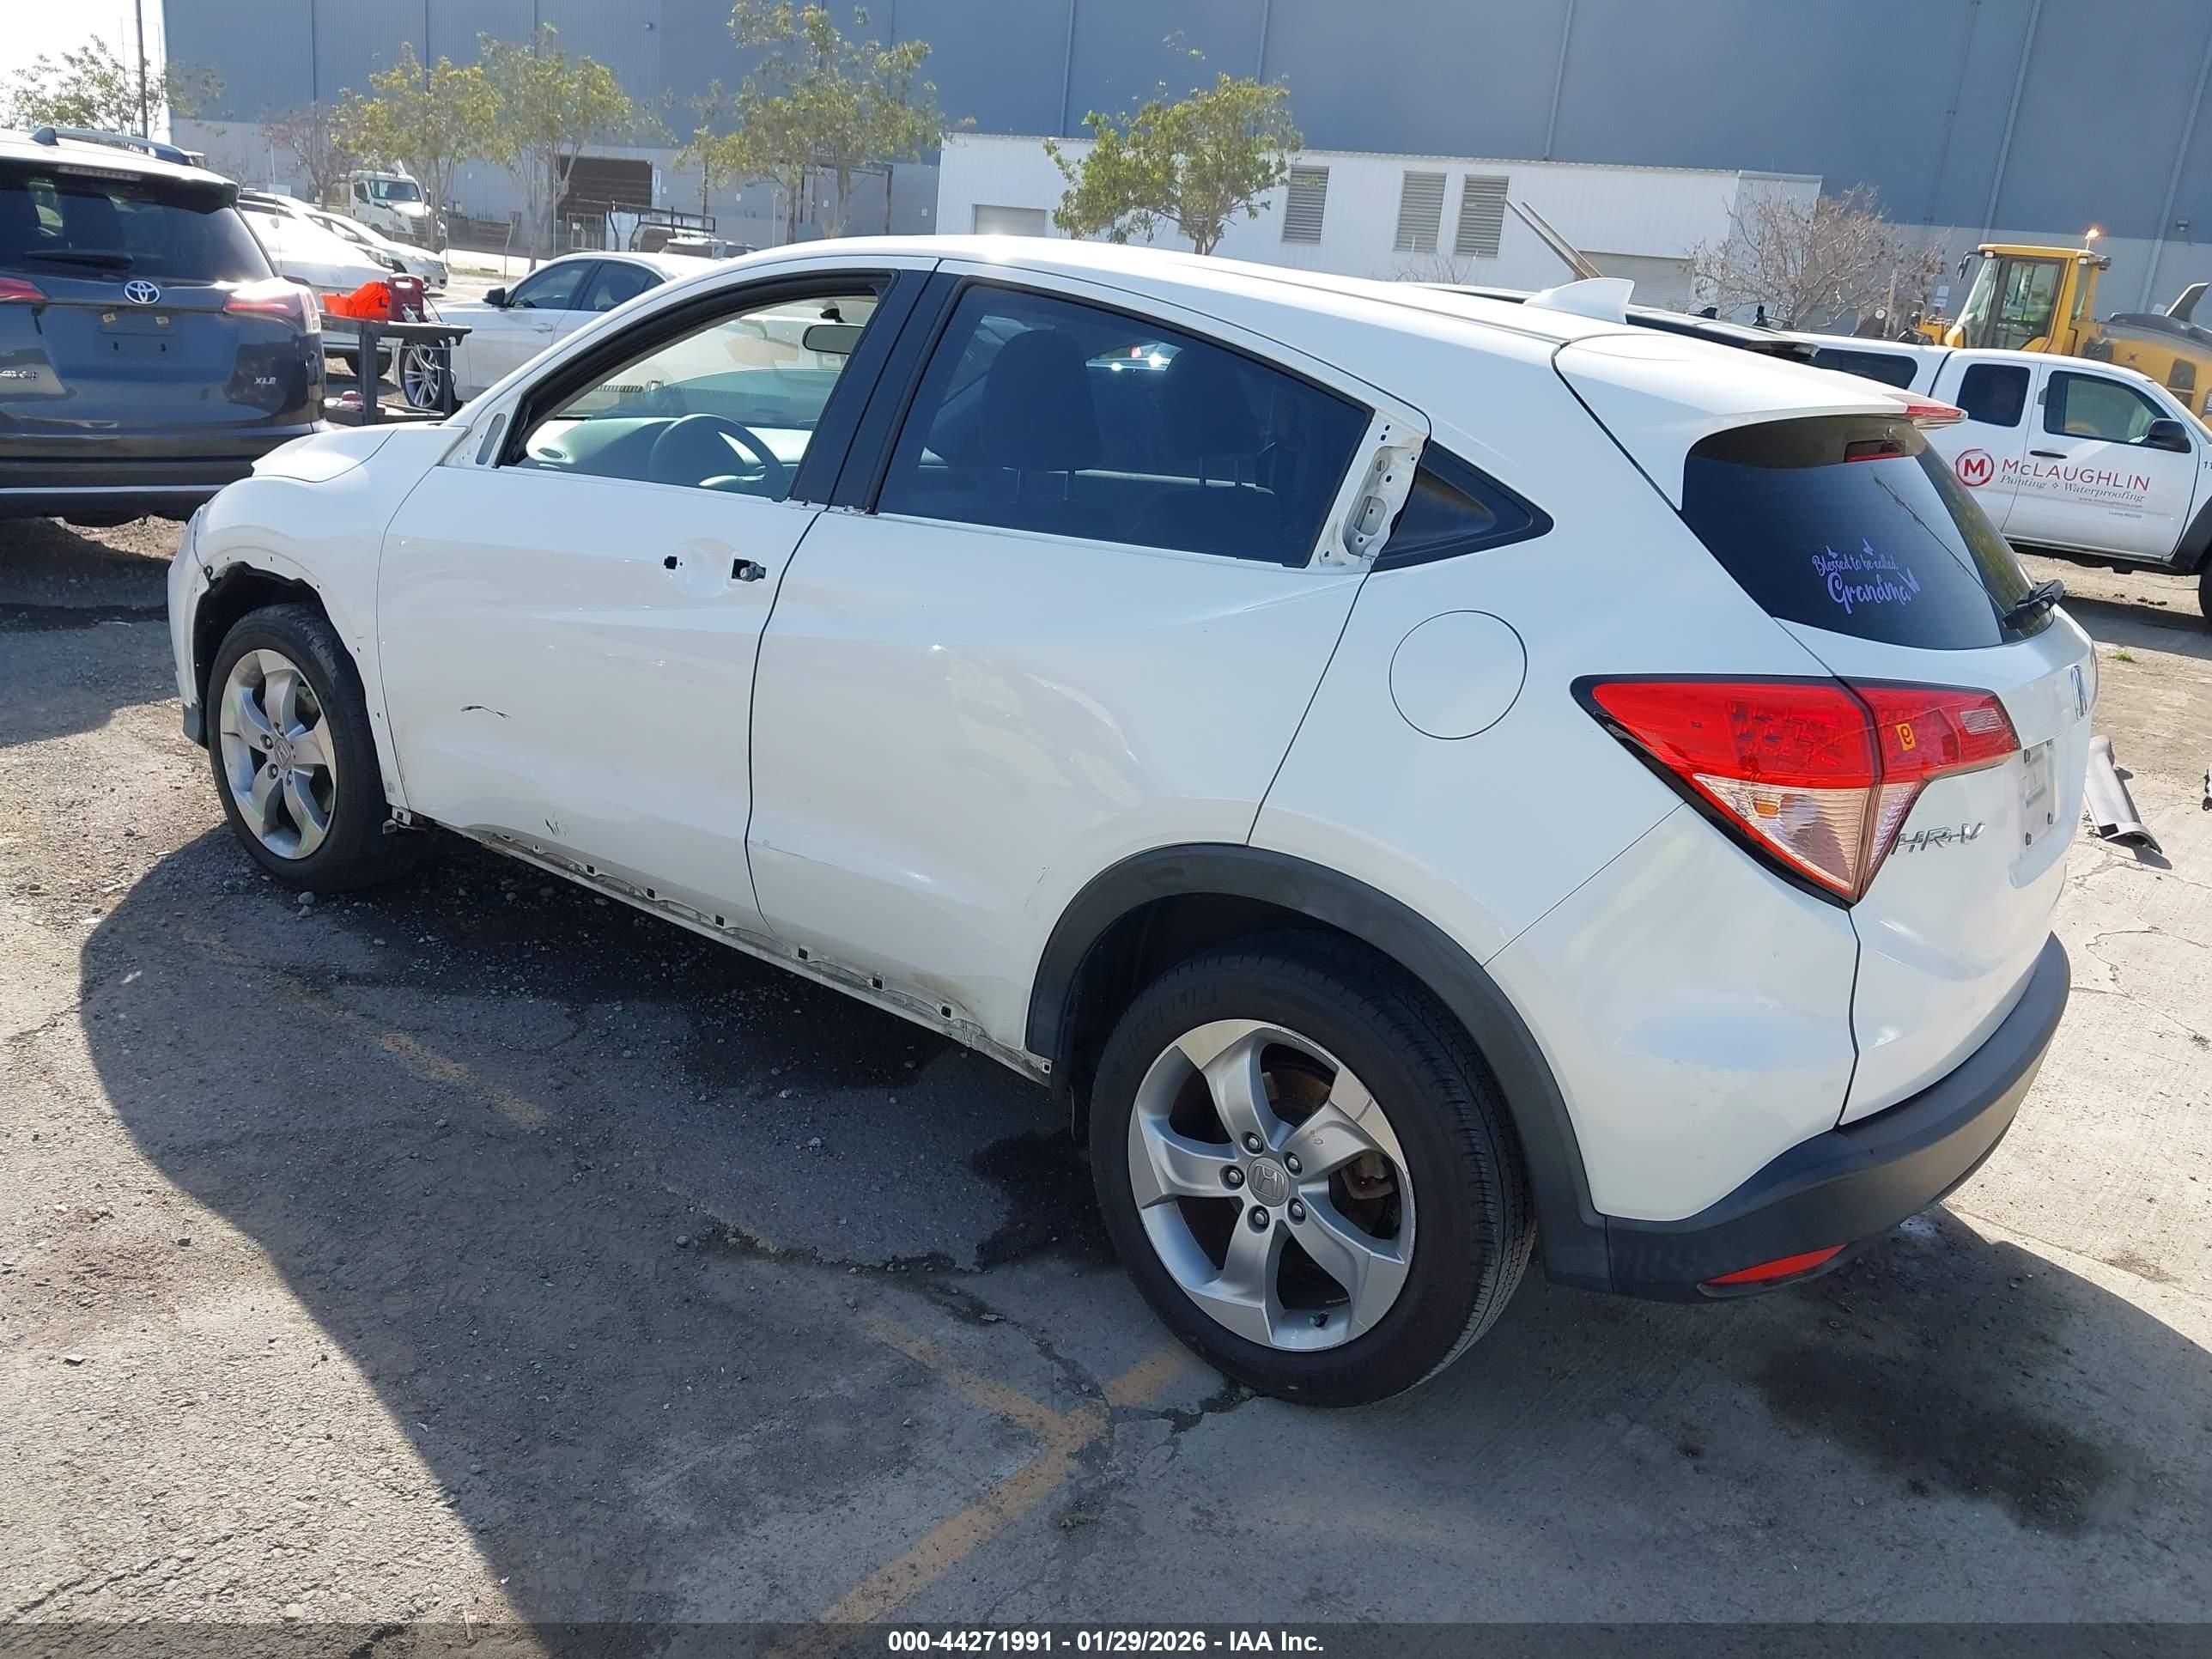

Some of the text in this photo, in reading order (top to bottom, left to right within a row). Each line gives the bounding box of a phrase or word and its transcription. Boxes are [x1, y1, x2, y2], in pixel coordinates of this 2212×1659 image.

[2000, 474, 2145, 503] Painting Waterproofing
[2002, 459, 2150, 490] McLAUGHLIN
[1812, 555, 1851, 576] Blessed
[1850, 554, 1862, 571] to
[1827, 571, 1911, 615] Grandma
[1890, 822, 1985, 855] HR-V
